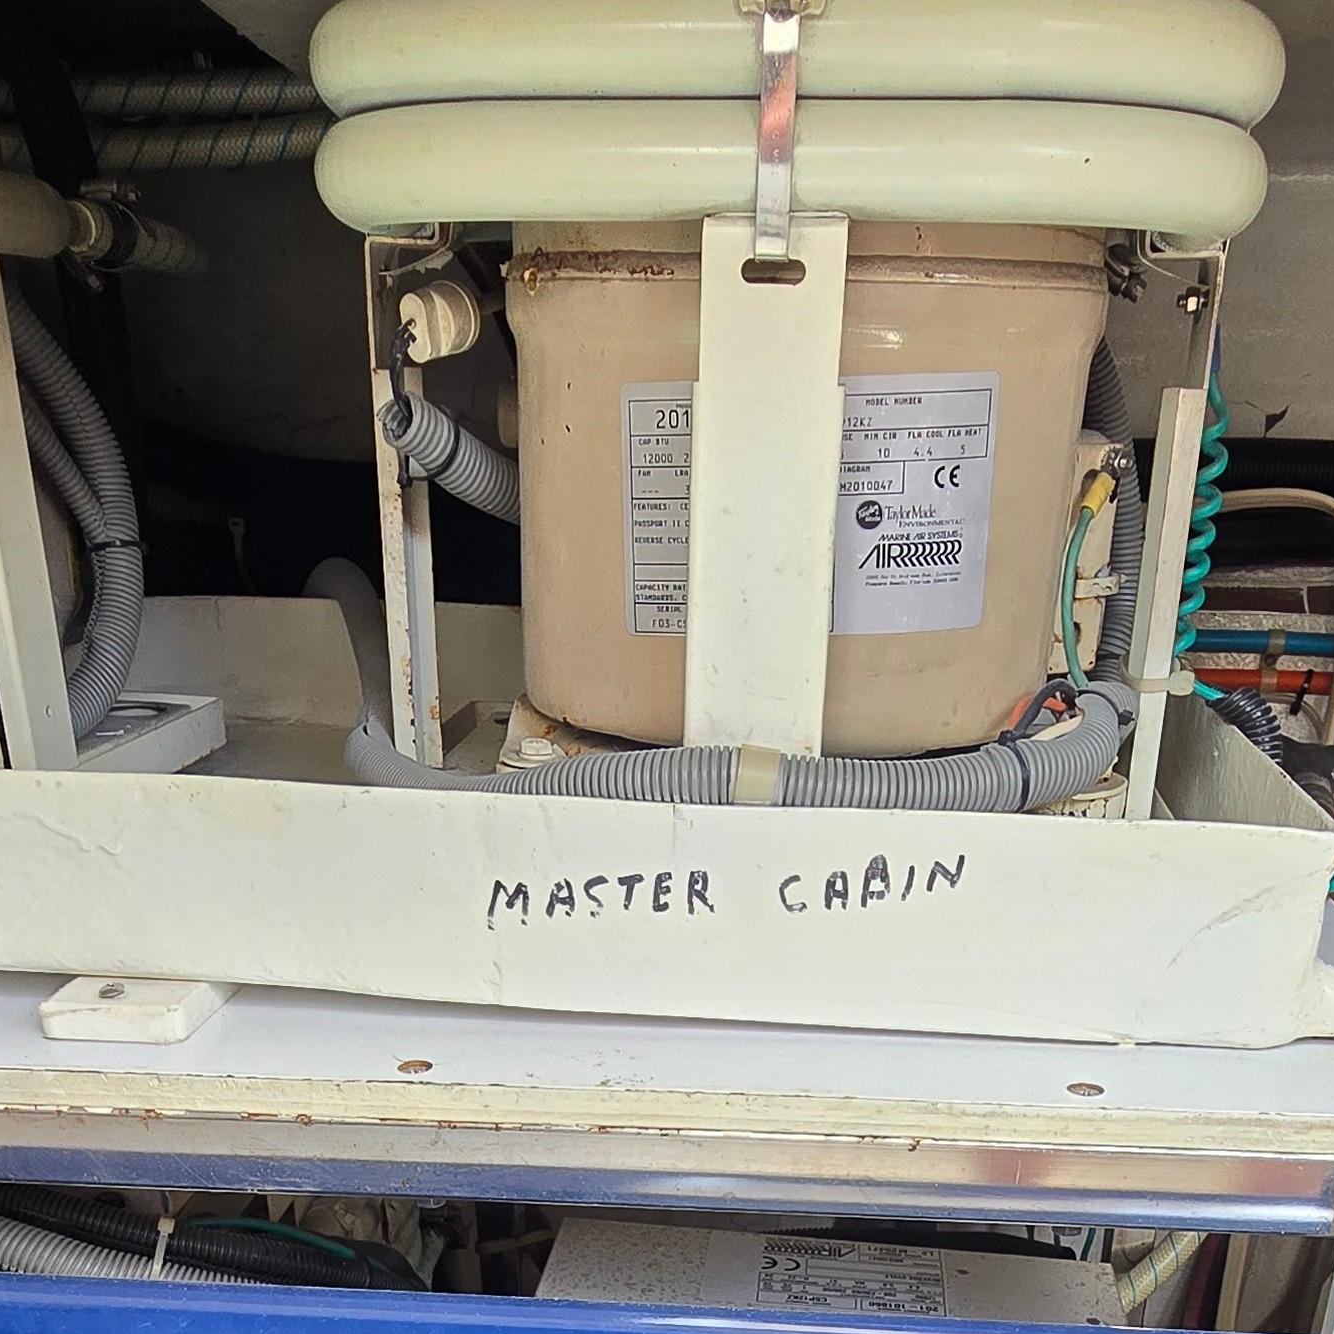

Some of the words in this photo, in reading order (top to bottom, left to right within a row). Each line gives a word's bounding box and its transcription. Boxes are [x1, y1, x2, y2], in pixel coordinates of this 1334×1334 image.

[865, 397, 889, 406] MODEL
[893, 396, 923, 405] NUMBER
[643, 453, 673, 464] 12000
[878, 448, 891, 459] 10
[913, 446, 933, 457] 4.4
[934, 464, 961, 489] CE
[487, 870, 715, 930] MASTER
[761, 1256, 801, 1271] CE
